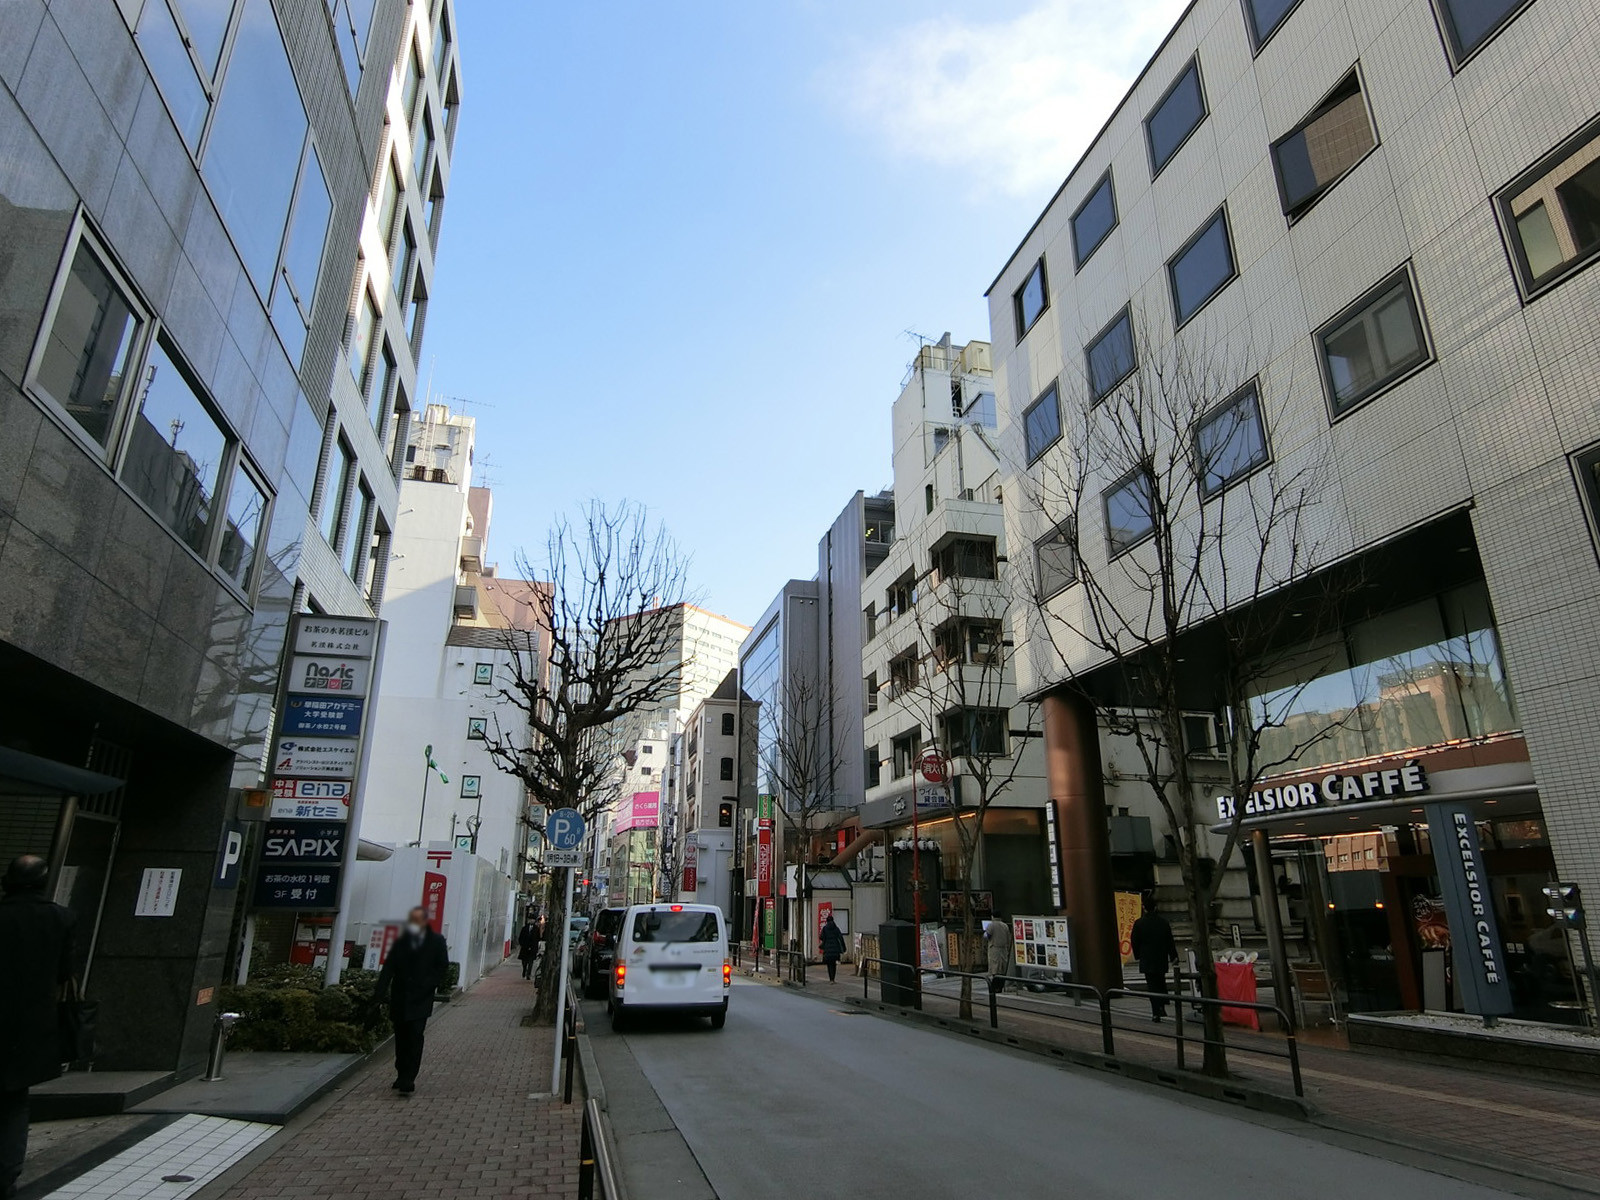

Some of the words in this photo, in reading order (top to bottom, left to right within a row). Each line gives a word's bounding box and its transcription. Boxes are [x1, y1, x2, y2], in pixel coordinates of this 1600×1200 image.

[304, 677, 353, 690] ナジック
[304, 701, 361, 711] 早稲田アカデミー
[304, 711, 344, 719] 大学受験部
[301, 783, 346, 796] ena
[1216, 782, 1318, 819] EXELSIOR
[1321, 760, 1424, 801] CAFFÉ
[295, 805, 338, 817] 新セミ
[554, 818, 570, 844] P
[564, 834, 576, 845] 60
[265, 838, 340, 857] SAPIX
[220, 830, 242, 879] P
[274, 890, 288, 898] 3F
[291, 888, 317, 899] 受付
[1453, 813, 1485, 916] EXCELSIOR
[1476, 920, 1501, 984] CAFFÉ
